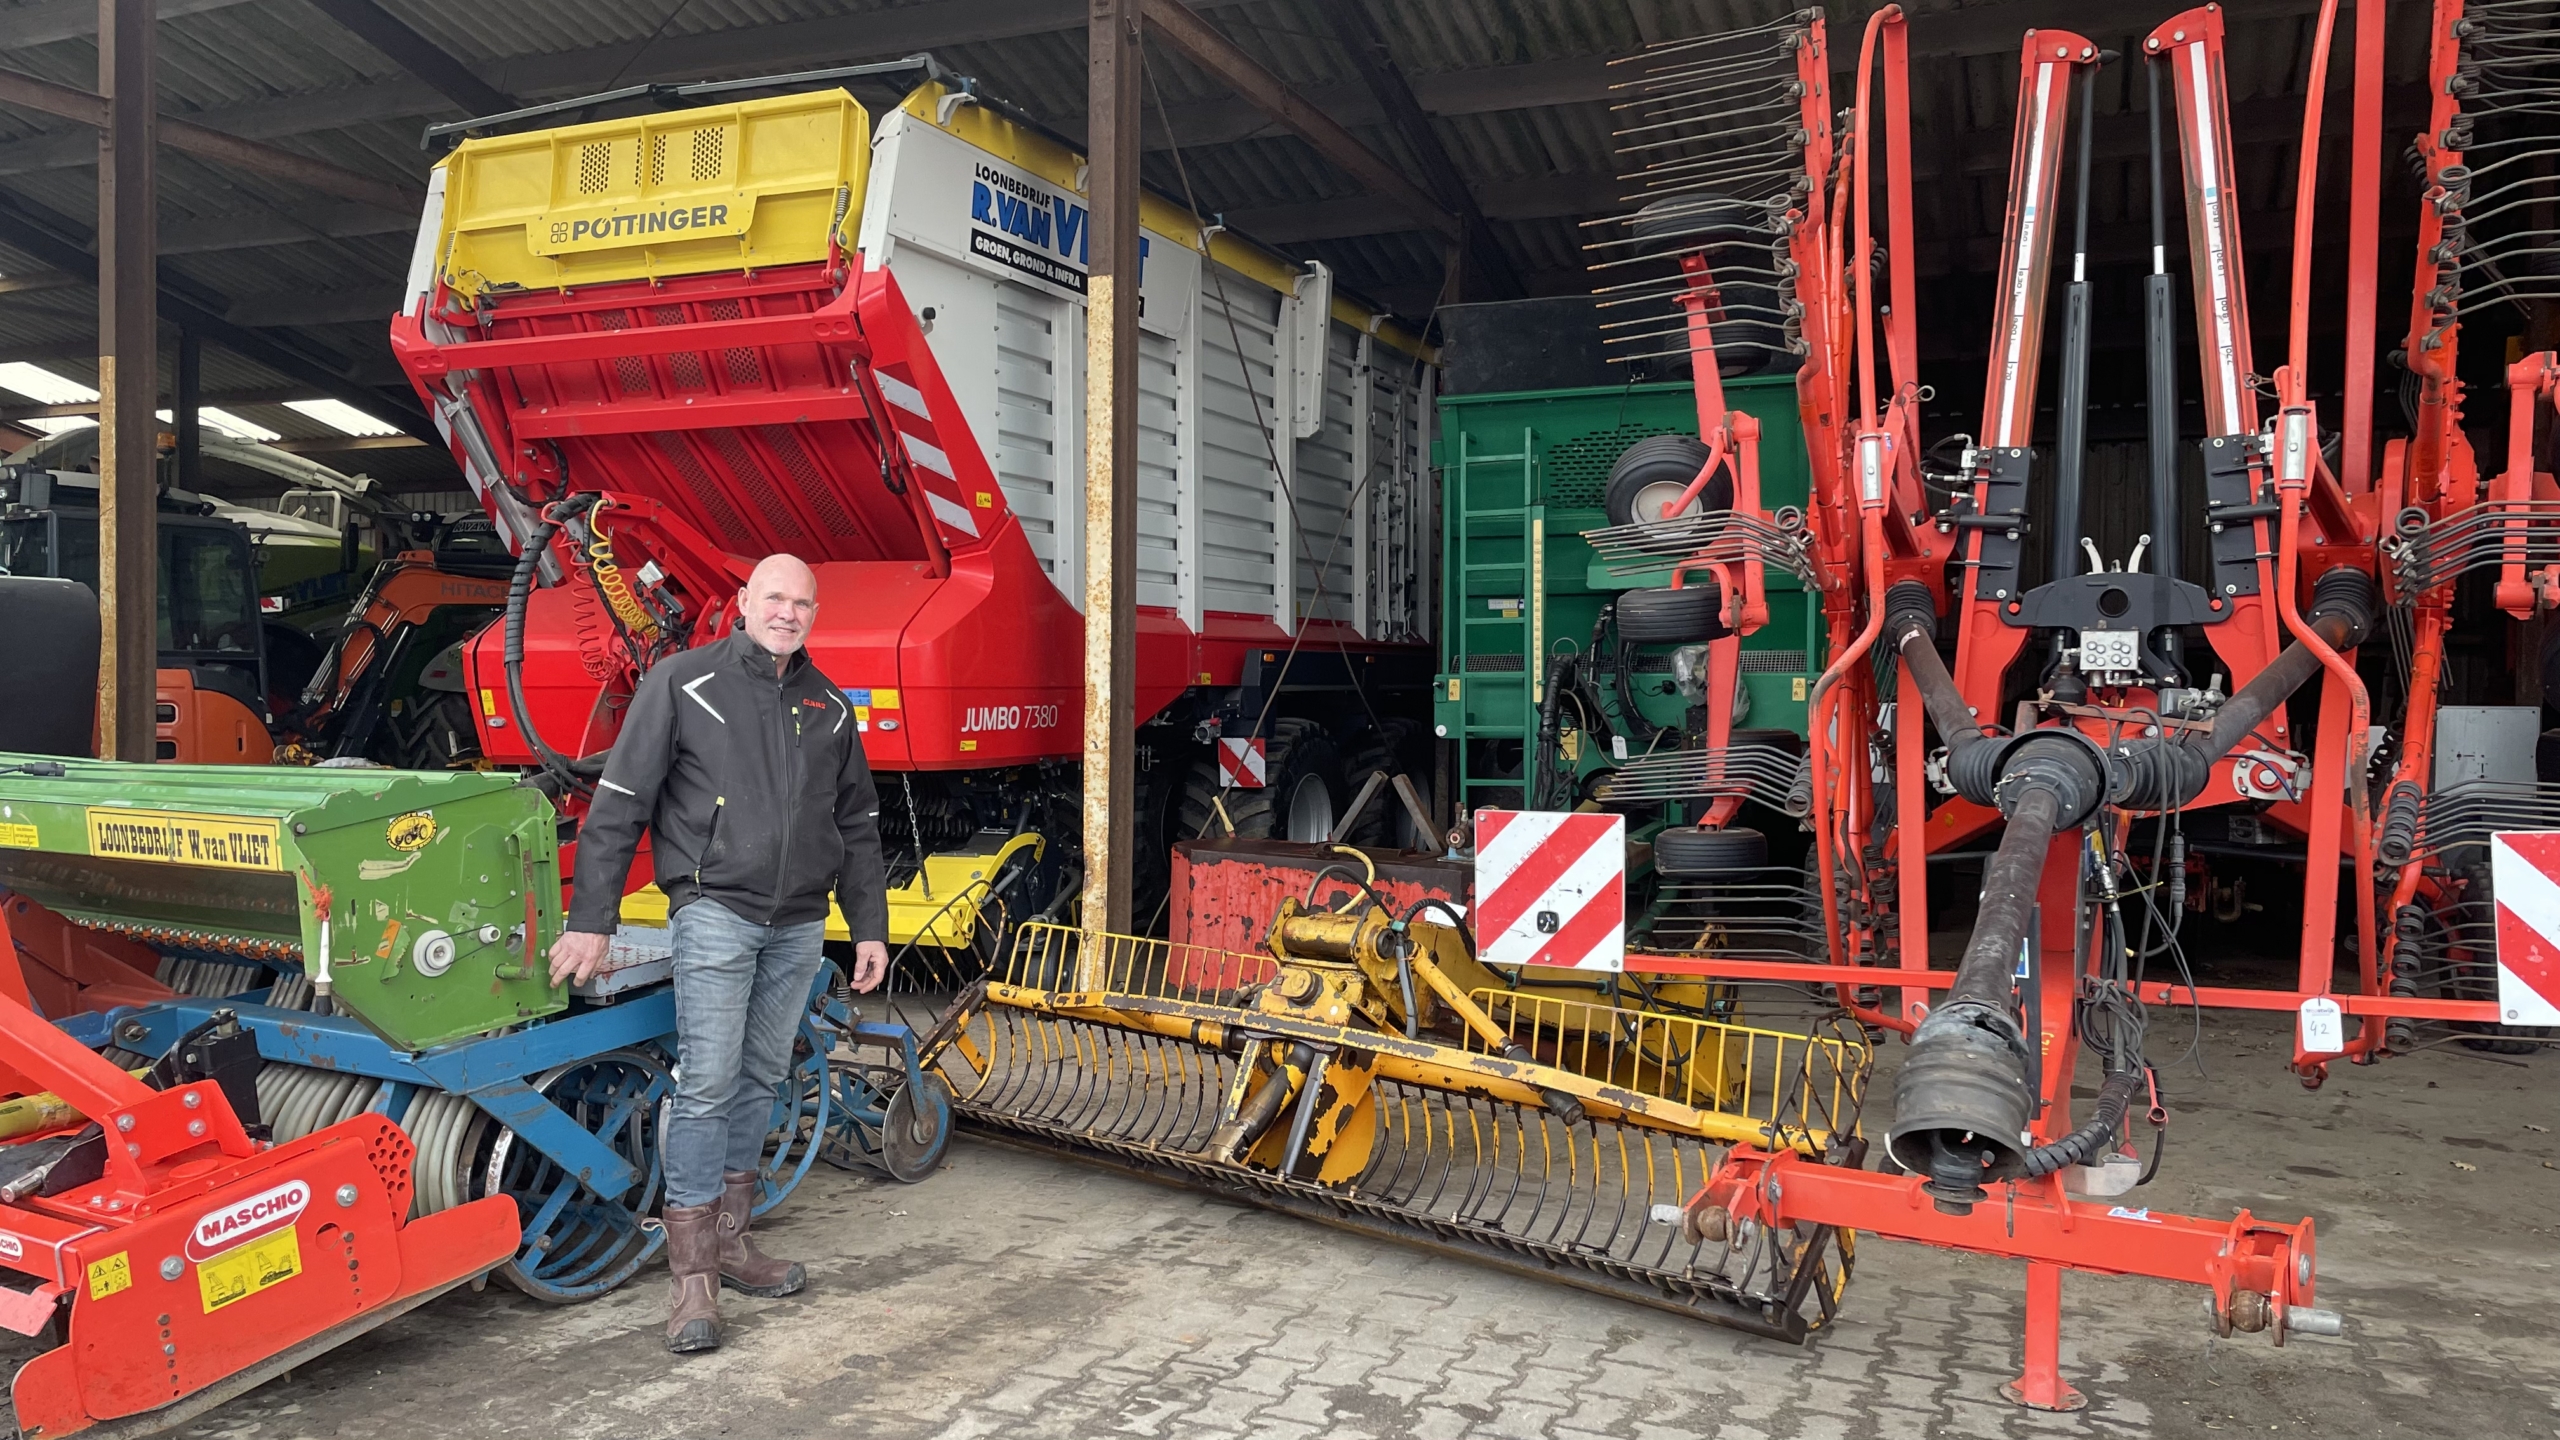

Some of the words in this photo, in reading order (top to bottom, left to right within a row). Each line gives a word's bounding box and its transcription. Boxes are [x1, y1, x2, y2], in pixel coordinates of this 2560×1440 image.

[975, 162, 1050, 208] LOONBEDRIJF
[975, 235, 1012, 264] GROEN,
[1012, 250, 1046, 275] GROND
[1046, 263, 1054, 278] &
[1055, 267, 1081, 289] INFRA
[441, 582, 510, 600] HITACH
[961, 705, 1020, 733] JUMBO
[1024, 704, 1058, 729] 7380
[98, 822, 183, 858] LOONBEDRIJF
[229, 832, 270, 866] VLIET
[202, 1188, 303, 1242] MASCHIO
